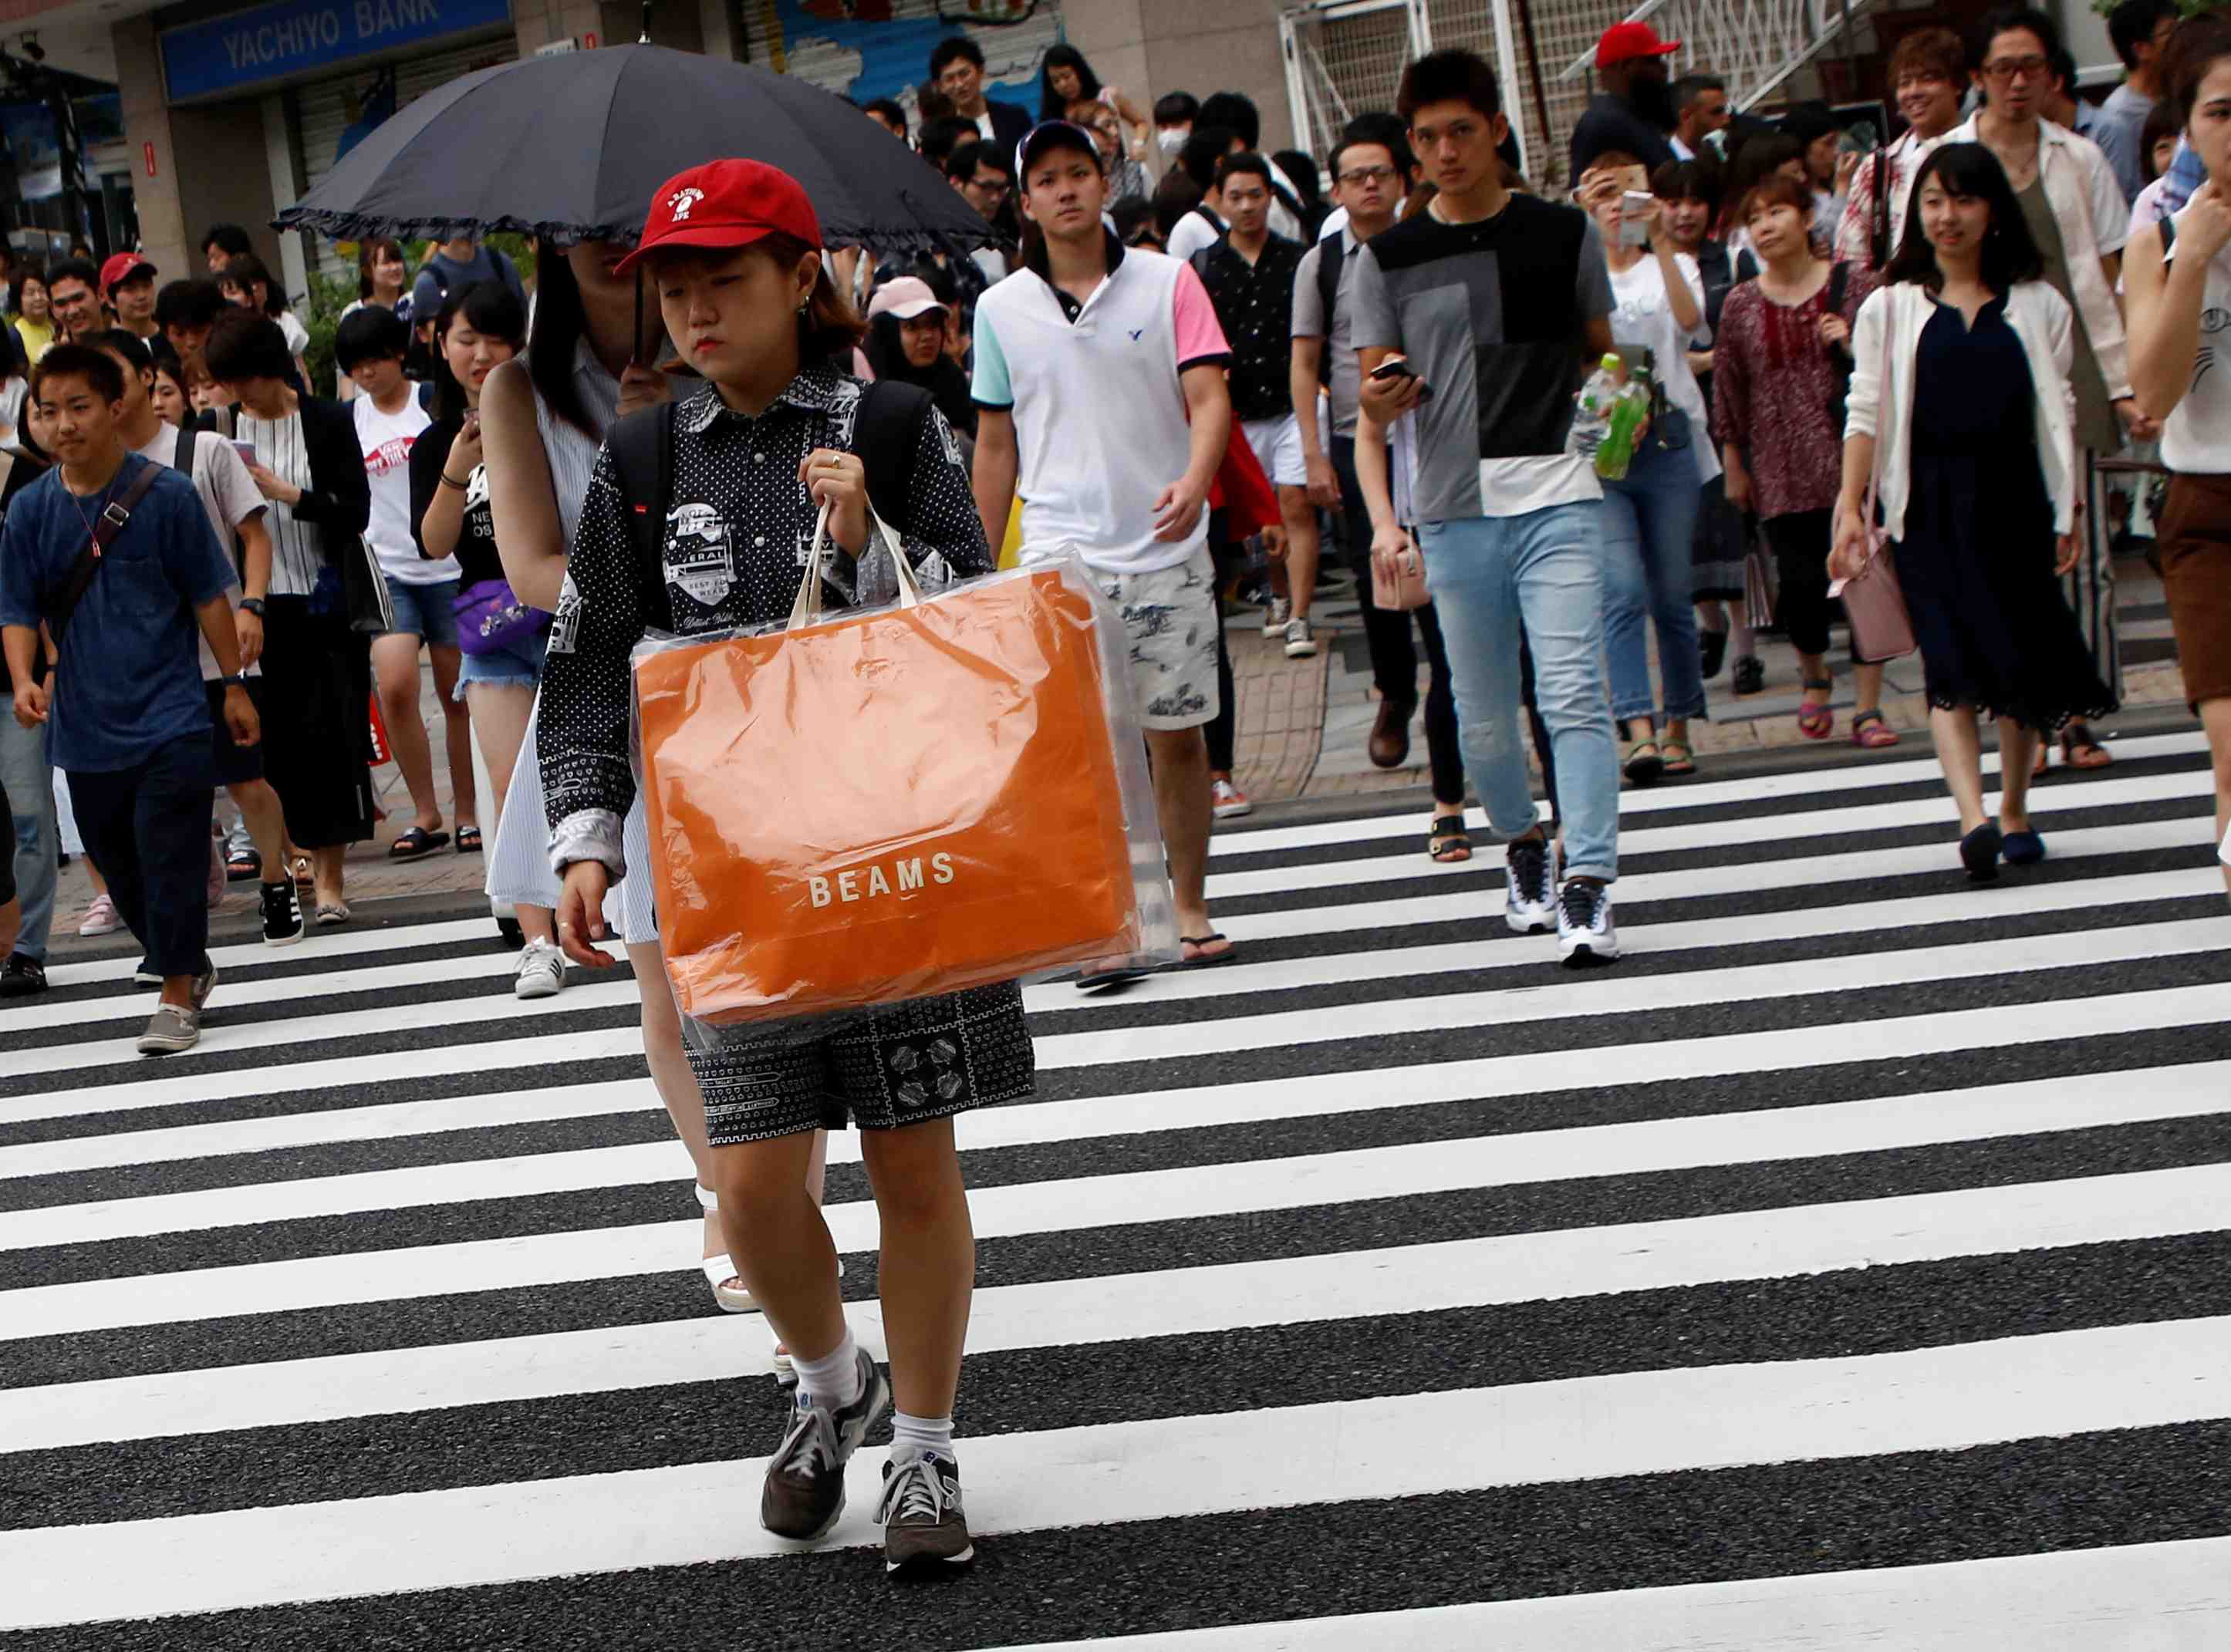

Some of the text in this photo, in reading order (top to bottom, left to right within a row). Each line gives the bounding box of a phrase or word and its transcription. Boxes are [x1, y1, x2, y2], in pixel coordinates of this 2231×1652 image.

[222, 0, 438, 69] YACHIYO BANK
[809, 851, 955, 909] BEAMS
